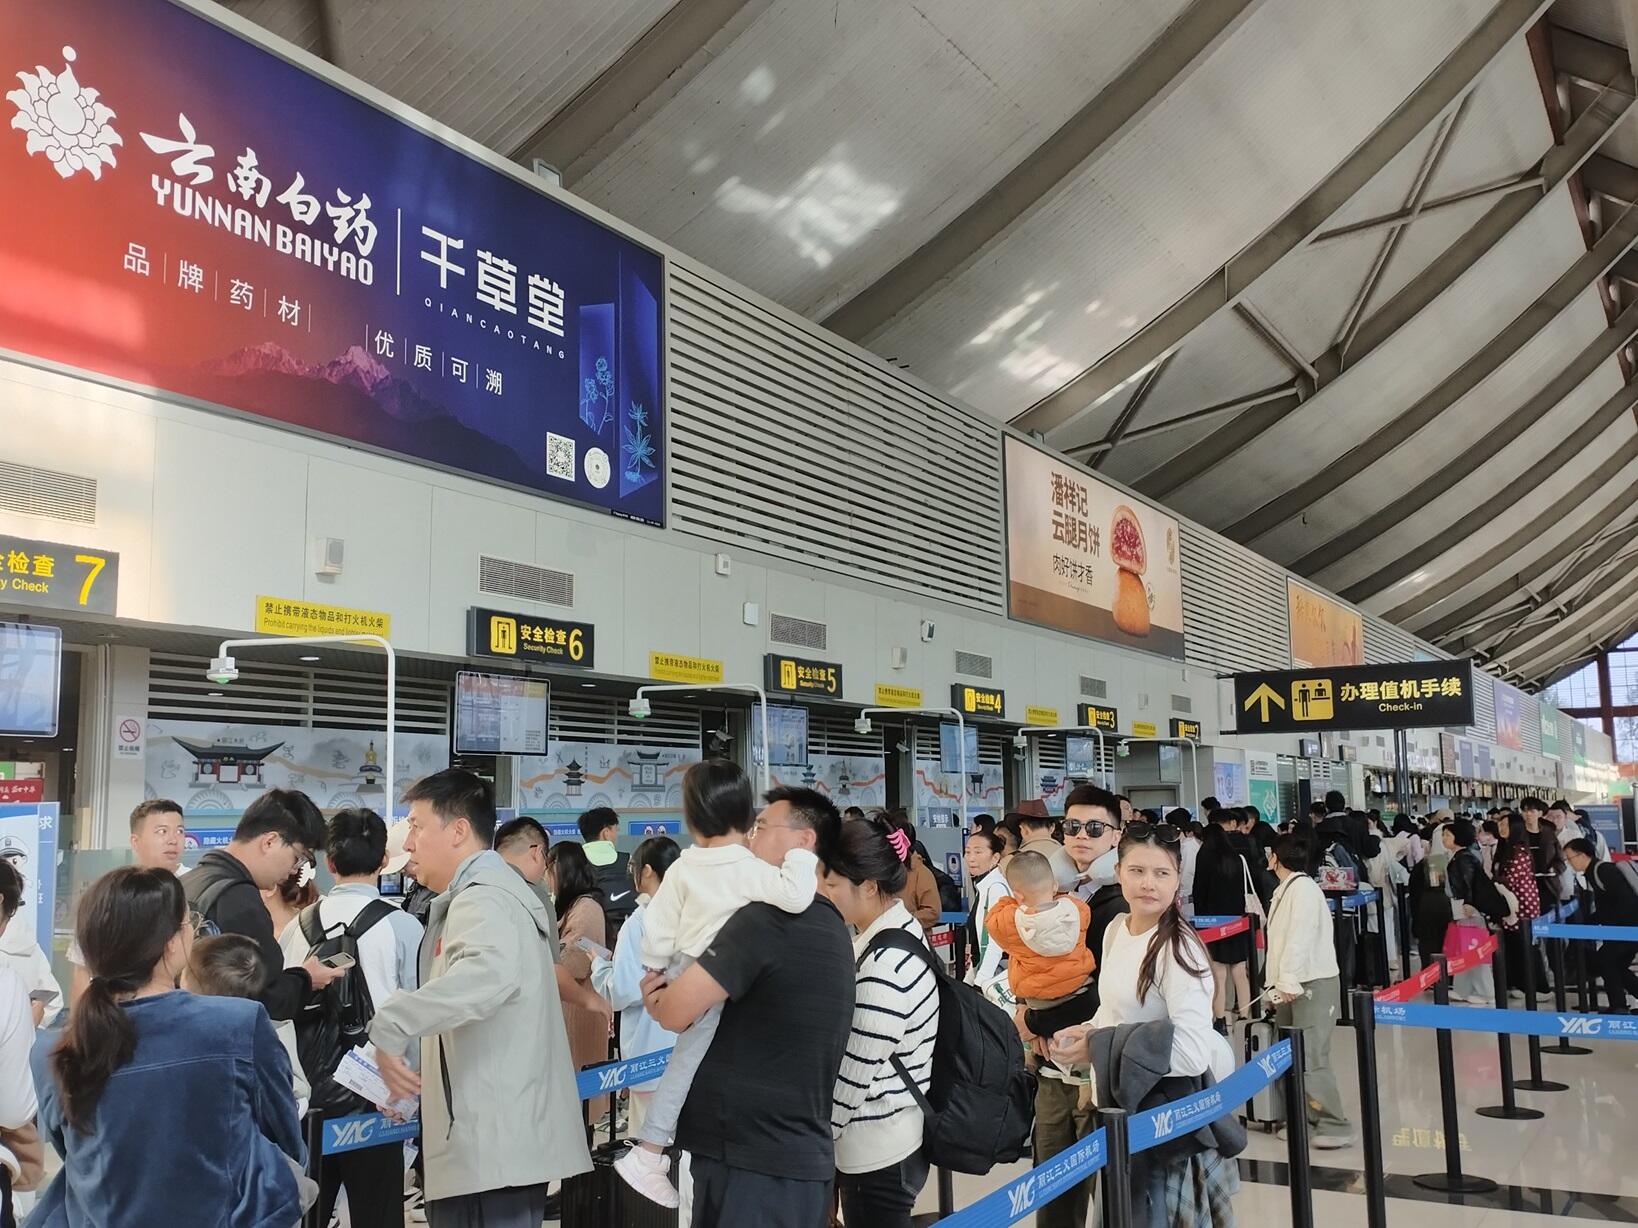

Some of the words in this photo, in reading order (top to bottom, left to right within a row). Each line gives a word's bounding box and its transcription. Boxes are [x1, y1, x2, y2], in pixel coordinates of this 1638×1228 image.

[139, 112, 378, 257] 云南白药
[151, 173, 271, 247] YUNNAN
[276, 223, 374, 286] BAIYAO
[420, 225, 565, 337] 千草堂
[1051, 471, 1088, 518] 潘祥记
[1052, 509, 1100, 558] 云腿月饼
[12, 578, 49, 593] Check
[75, 554, 105, 605] 7
[520, 624, 567, 645] 安全检查
[569, 628, 584, 661] 6
[523, 642, 546, 654] Security
[546, 646, 563, 655] Check
[797, 665, 826, 681] 安全检查
[827, 667, 837, 693] 5
[1340, 677, 1462, 702] 办理值机手续
[994, 693, 1002, 714] 4
[1109, 711, 1115, 729] 3
[1037, 1139, 1101, 1189] 丽江三义国际机场
